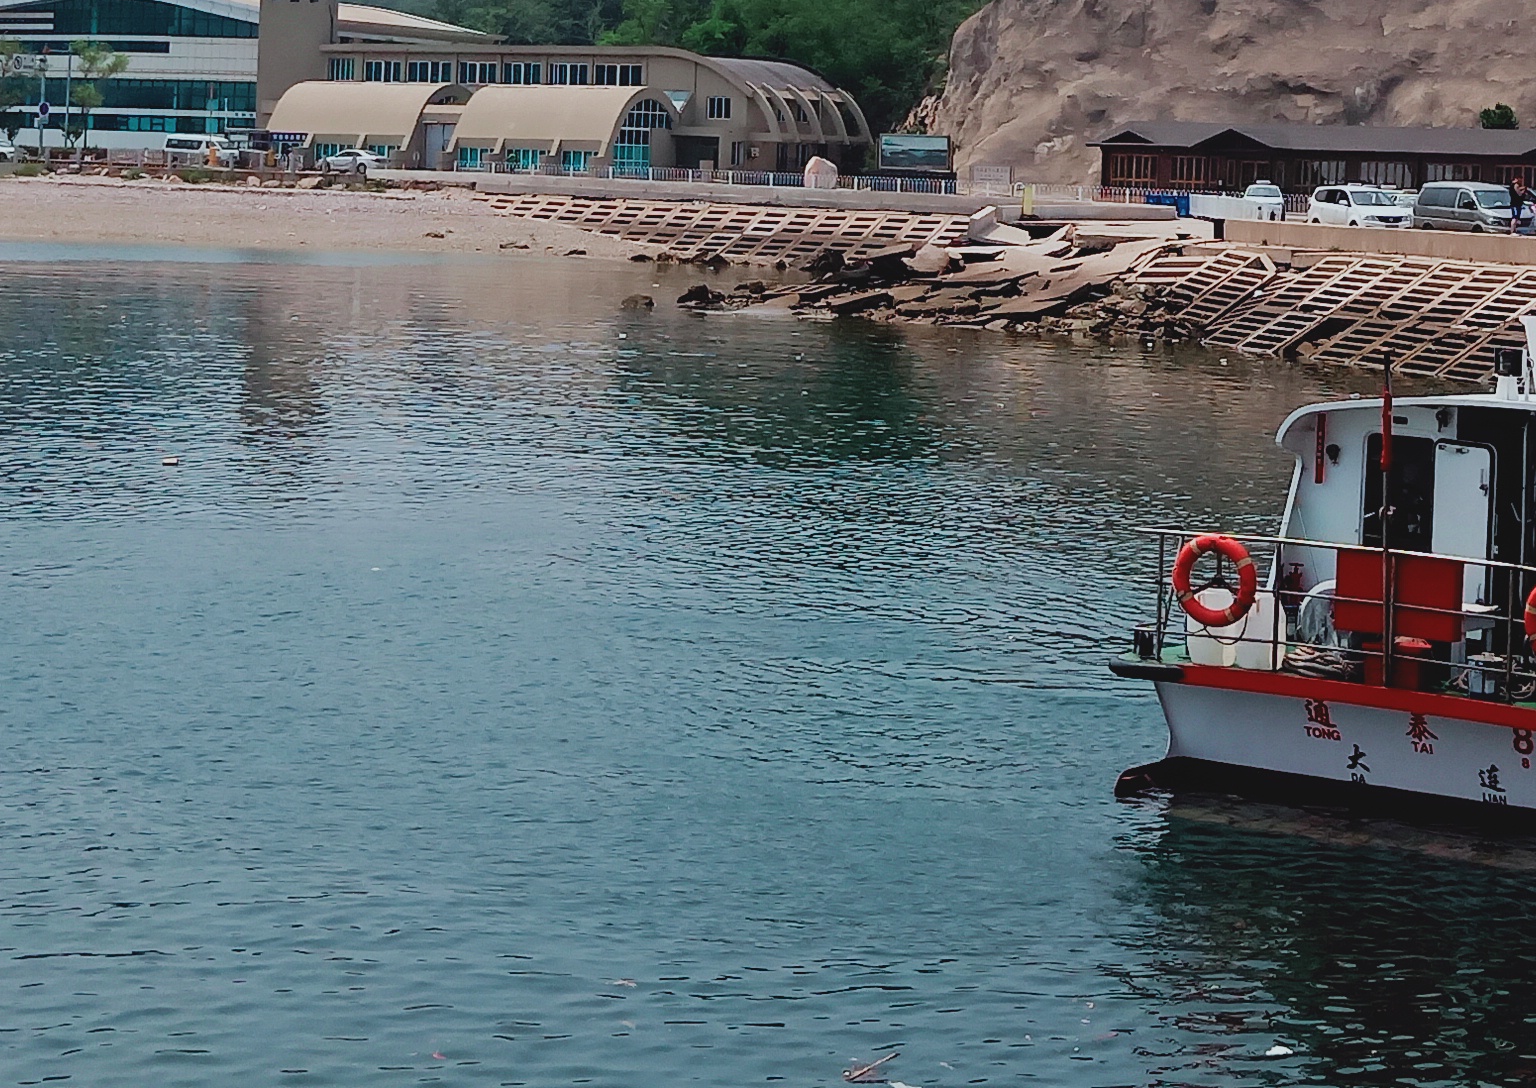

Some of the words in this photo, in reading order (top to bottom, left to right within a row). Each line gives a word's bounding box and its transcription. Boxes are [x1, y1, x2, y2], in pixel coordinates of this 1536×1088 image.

[1303, 725, 1342, 742] TONG
[1410, 740, 1435, 755] TAI
[1512, 727, 1535, 756] 8
[1346, 743, 1371, 773] 大
